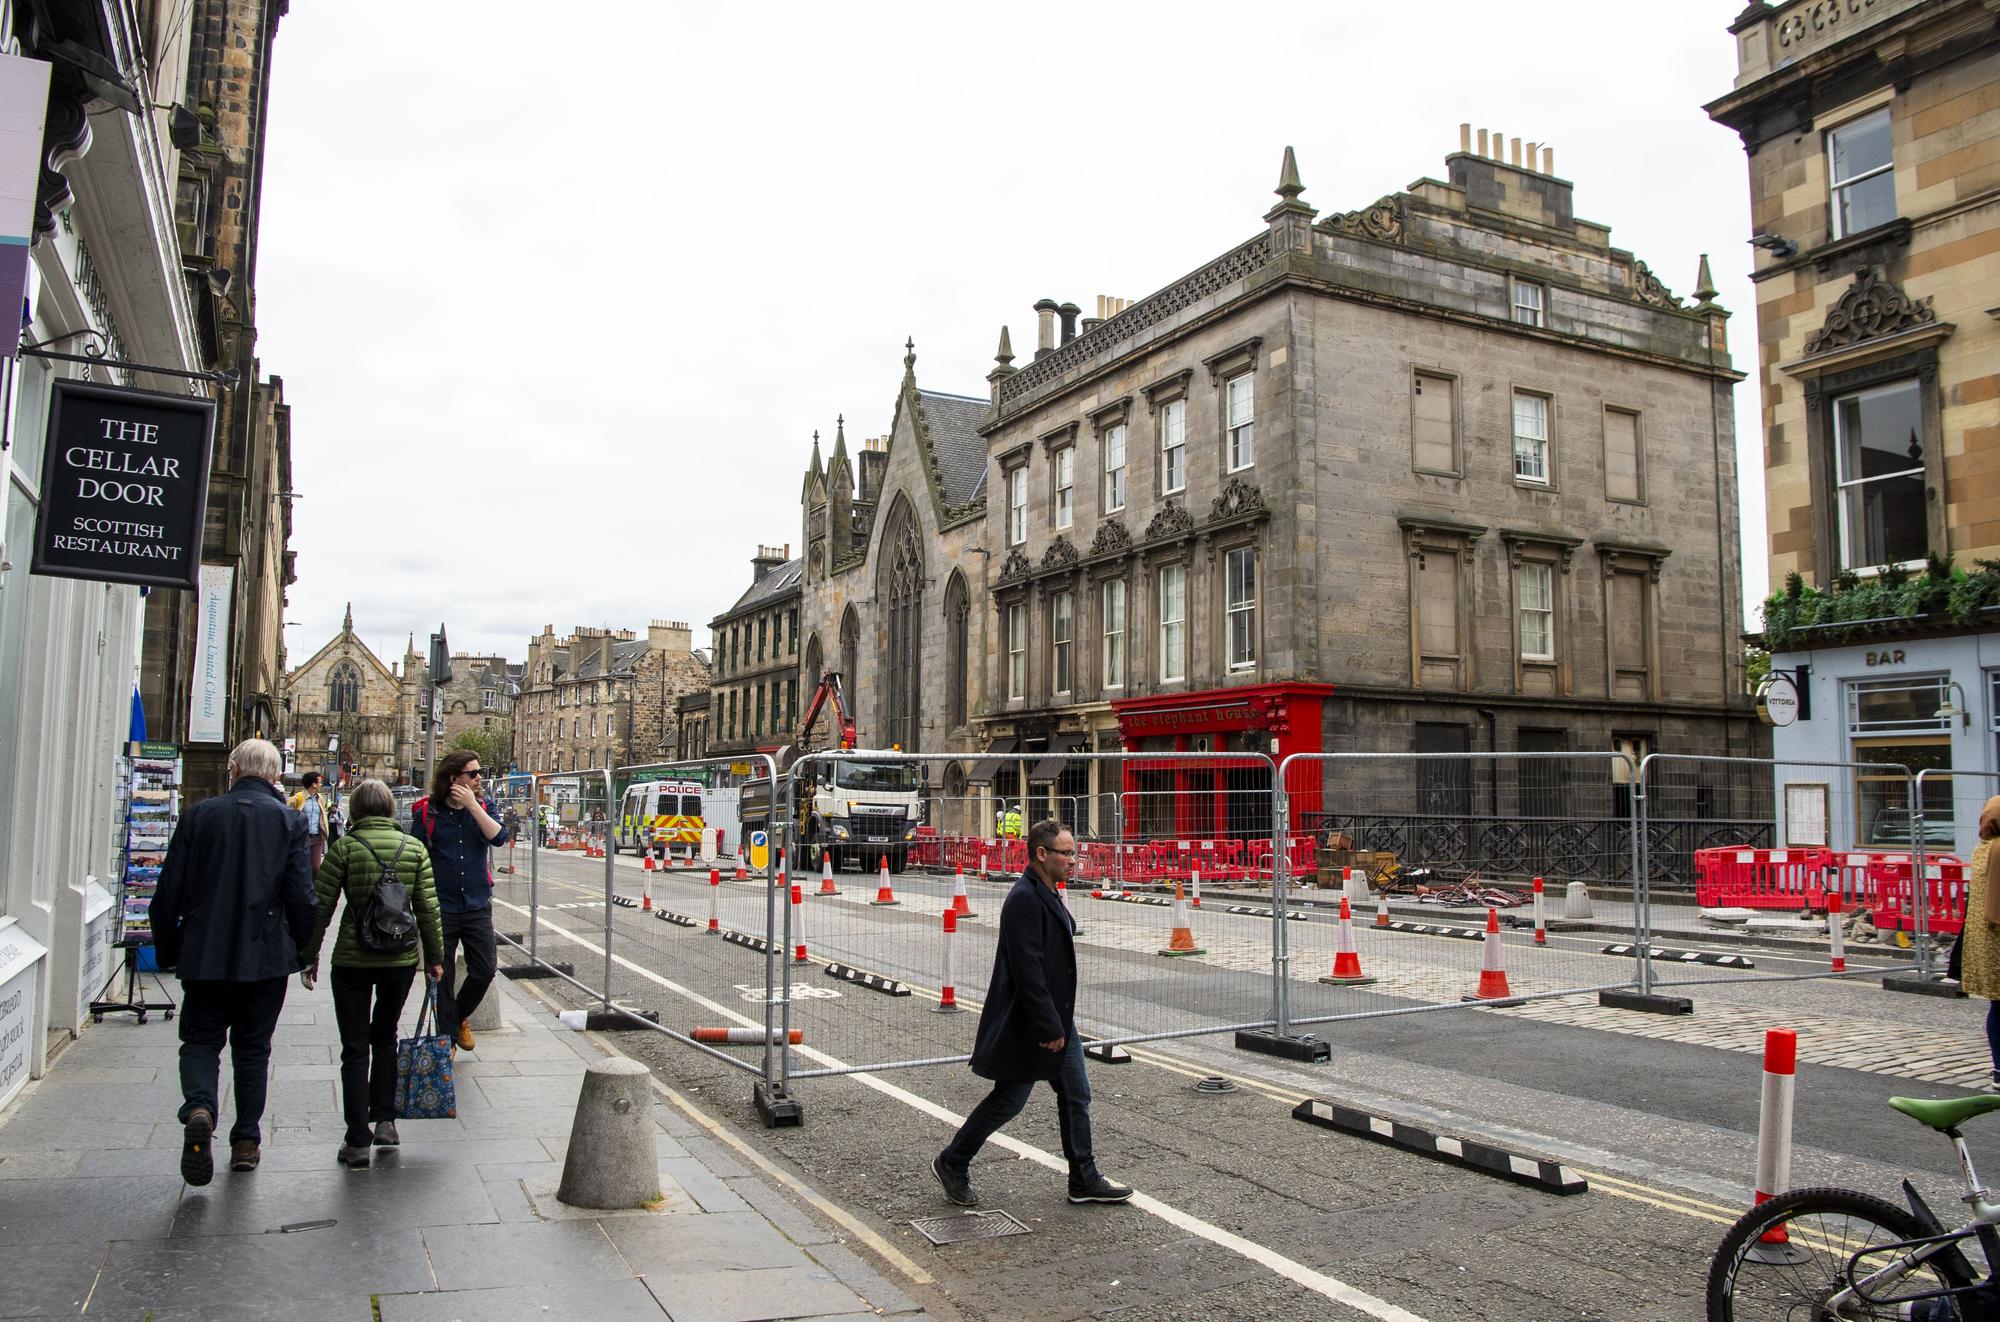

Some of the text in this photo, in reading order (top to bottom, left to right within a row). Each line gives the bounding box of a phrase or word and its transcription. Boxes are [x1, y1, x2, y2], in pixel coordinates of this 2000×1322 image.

[100, 418, 159, 445] THE
[65, 447, 180, 479] CELLAR
[77, 477, 165, 507] DOOR
[73, 517, 165, 539] SCOTTISH
[52, 534, 182, 561] RESTAURANT
[207, 592, 221, 641] Augustine
[205, 644, 218, 679] United
[1866, 649, 1906, 667] BAR
[203, 680, 217, 719] Church
[1768, 697, 1796, 706] VITTORIA
[1129, 706, 1259, 728] the elephant house
[659, 785, 702, 795] POLICE
